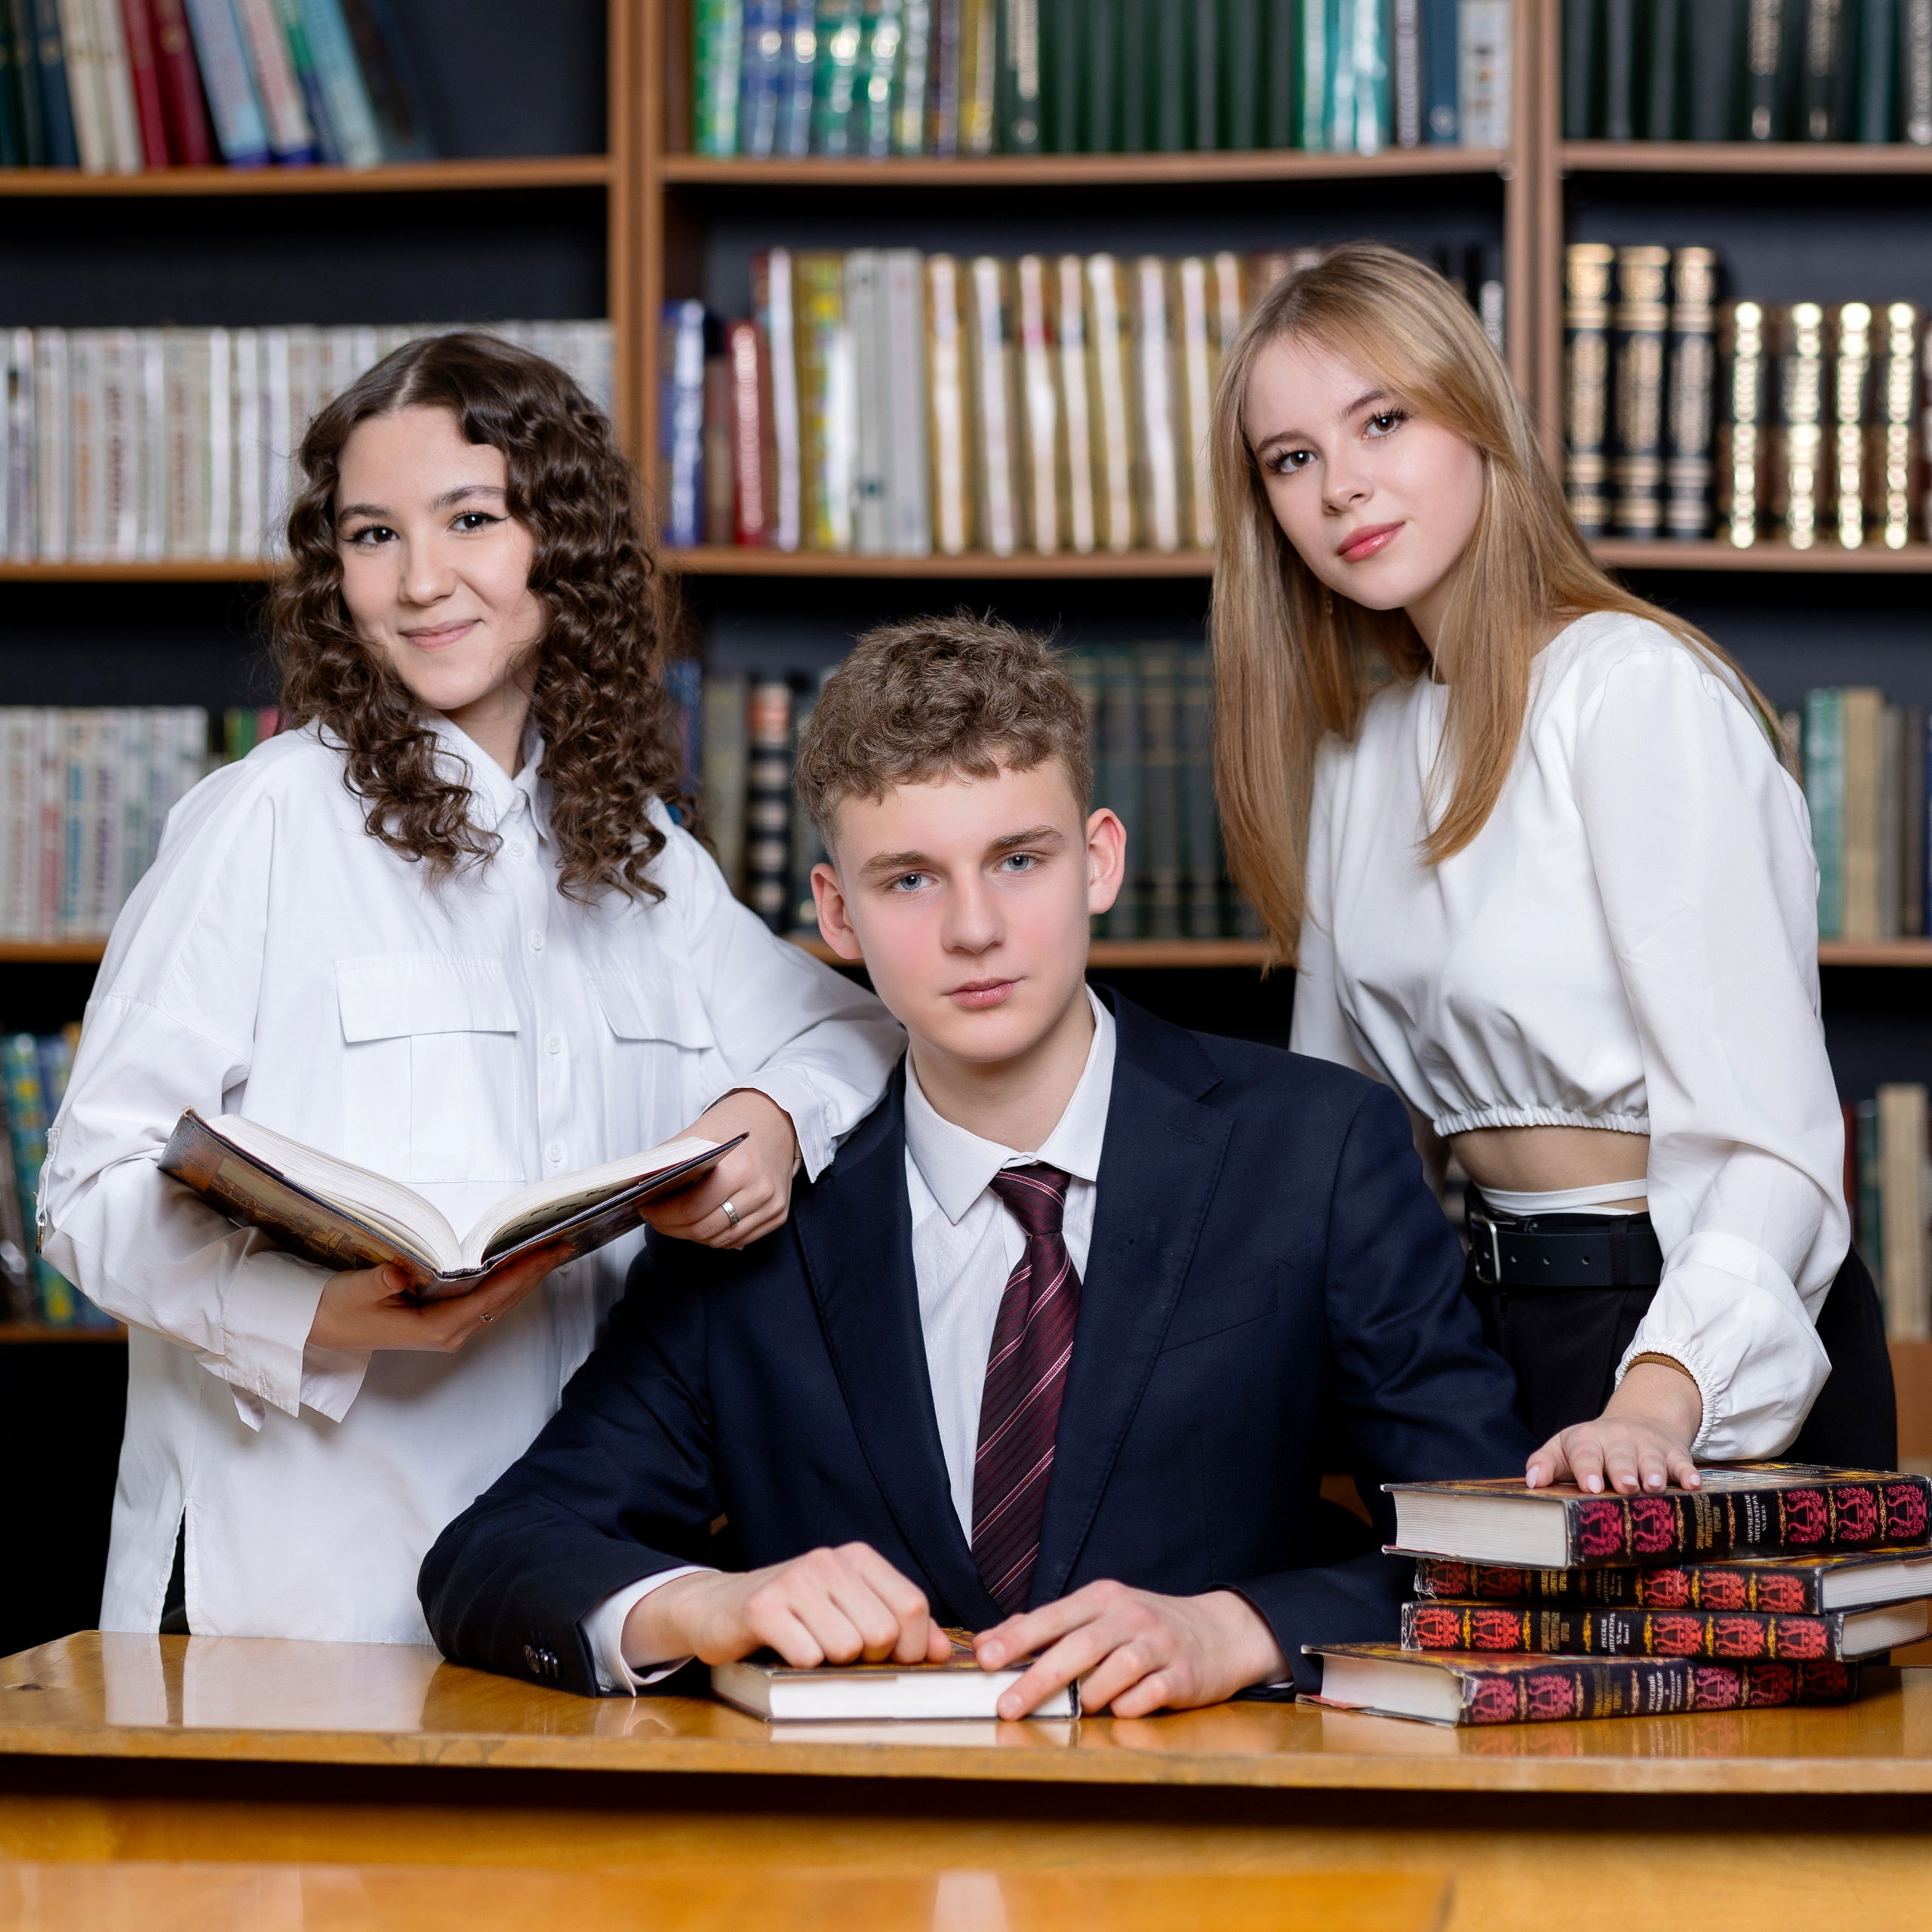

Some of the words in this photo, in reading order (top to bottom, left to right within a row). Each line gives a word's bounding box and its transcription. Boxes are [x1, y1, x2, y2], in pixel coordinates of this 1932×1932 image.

[1712, 1506, 1721, 1533] ГЕРОЕВ
[1744, 1495, 1753, 1543] ЗАРУБЕЖНАЯ
[1752, 1495, 1761, 1543] ЛИТЕРАТУРА
[1558, 1572, 1567, 1592] ГЕРОЕВ
[1647, 1675, 1656, 1710] РУССКИЙ
